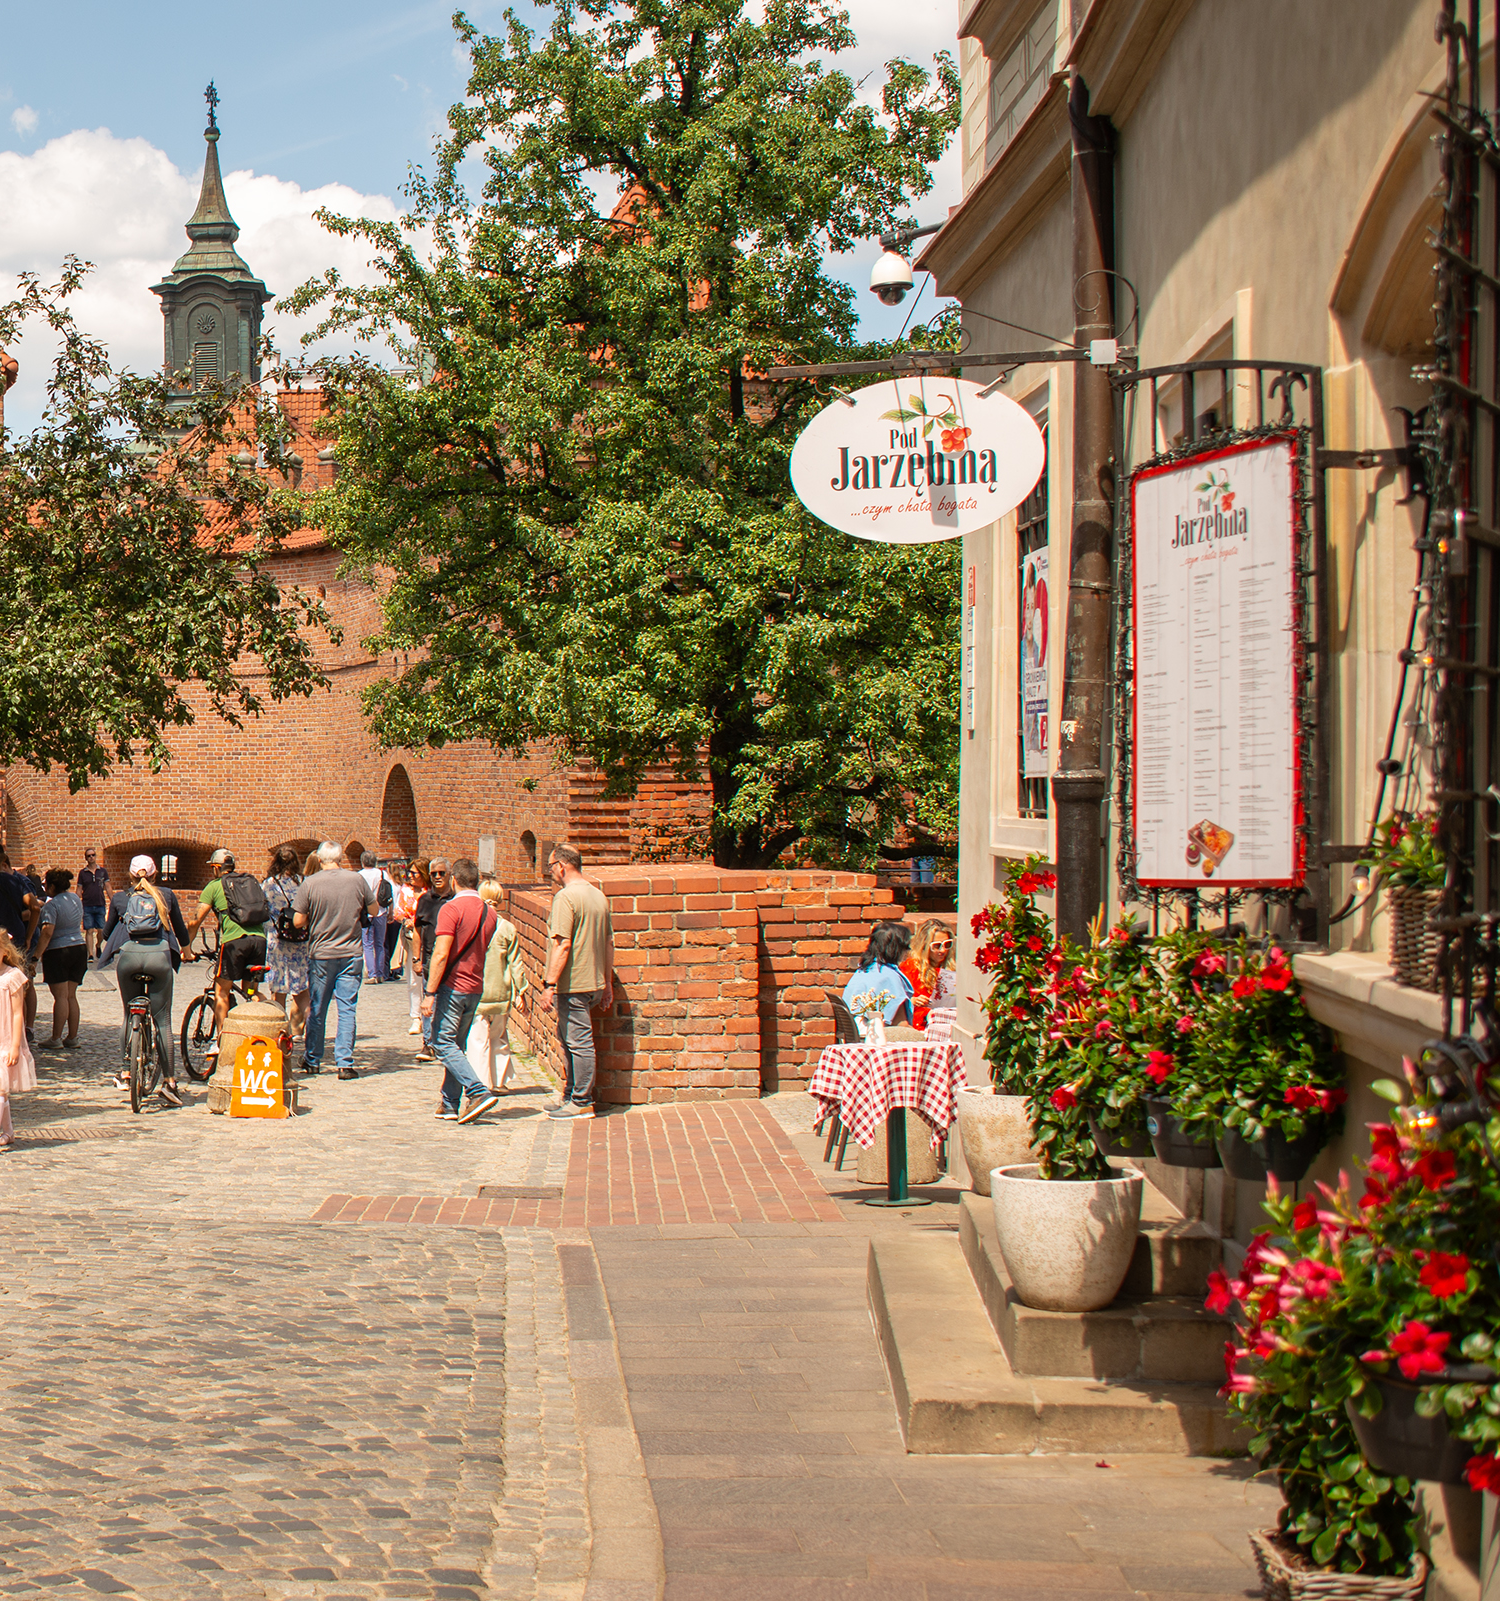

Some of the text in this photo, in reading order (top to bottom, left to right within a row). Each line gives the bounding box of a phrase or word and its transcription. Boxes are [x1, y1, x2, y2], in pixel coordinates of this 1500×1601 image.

[889, 427, 918, 449] Pod
[830, 440, 998, 497] Jarzębiną
[898, 497, 932, 513] chata
[937, 495, 978, 517] bogata
[1197, 495, 1211, 514] Pod
[239, 1068, 279, 1095] WC
